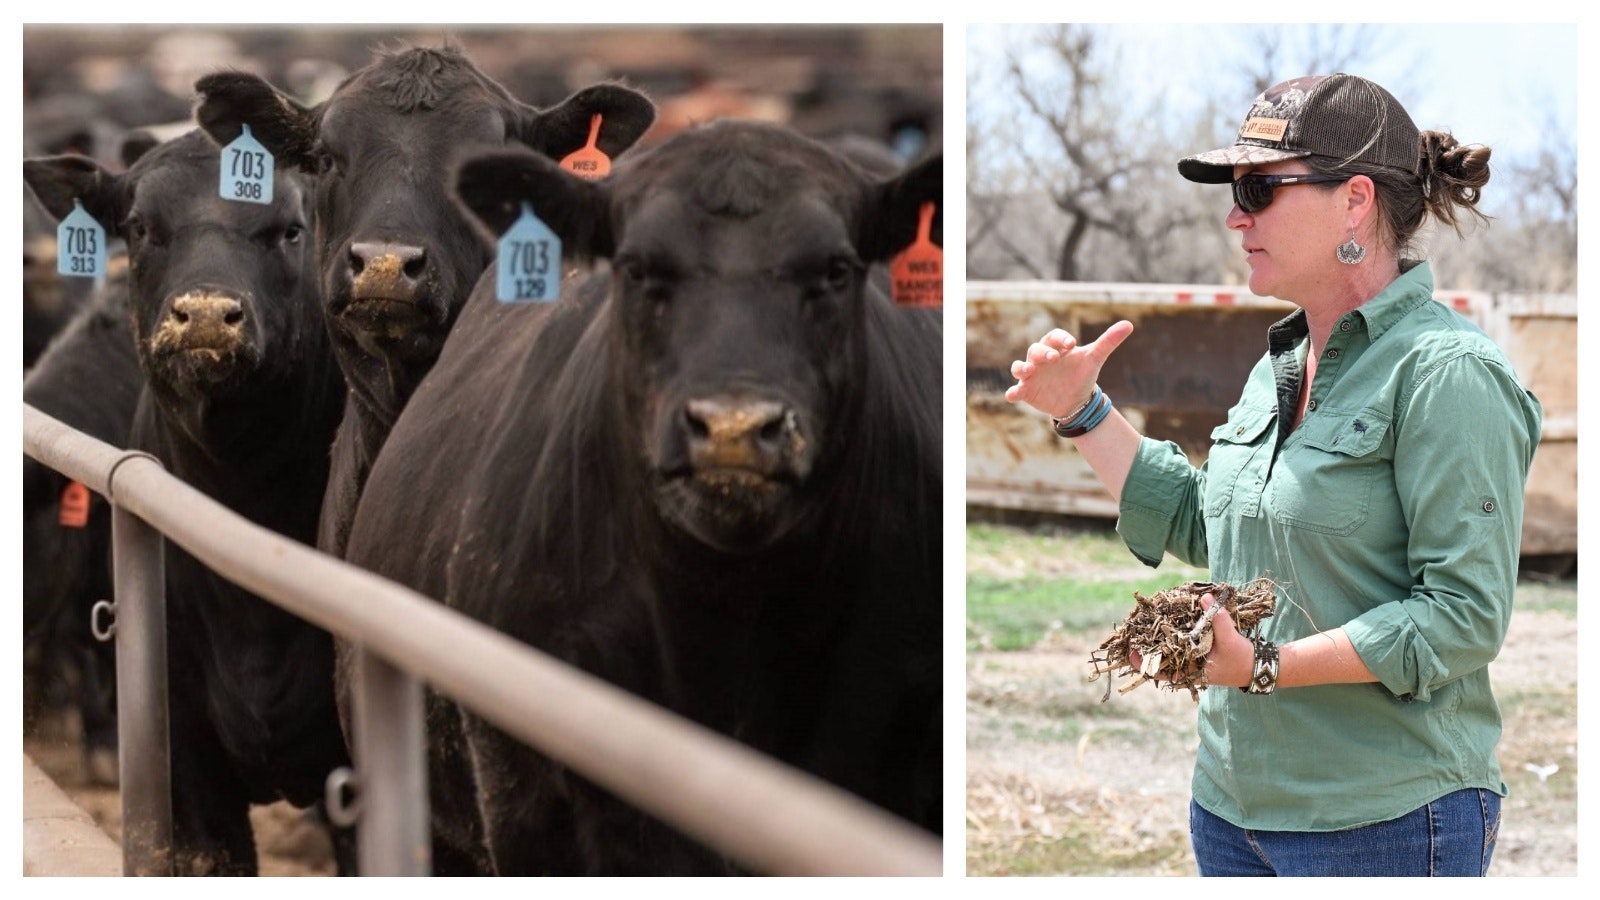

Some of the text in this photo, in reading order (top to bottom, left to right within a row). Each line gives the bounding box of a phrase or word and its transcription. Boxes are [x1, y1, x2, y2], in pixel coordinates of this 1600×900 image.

[231, 148, 265, 180] 703
[572, 160, 598, 171] WES
[234, 180, 262, 200] 308
[66, 226, 97, 255] 703
[70, 256, 96, 273] 313
[510, 240, 549, 276] 703
[907, 261, 940, 275] WES
[515, 278, 546, 299] 129
